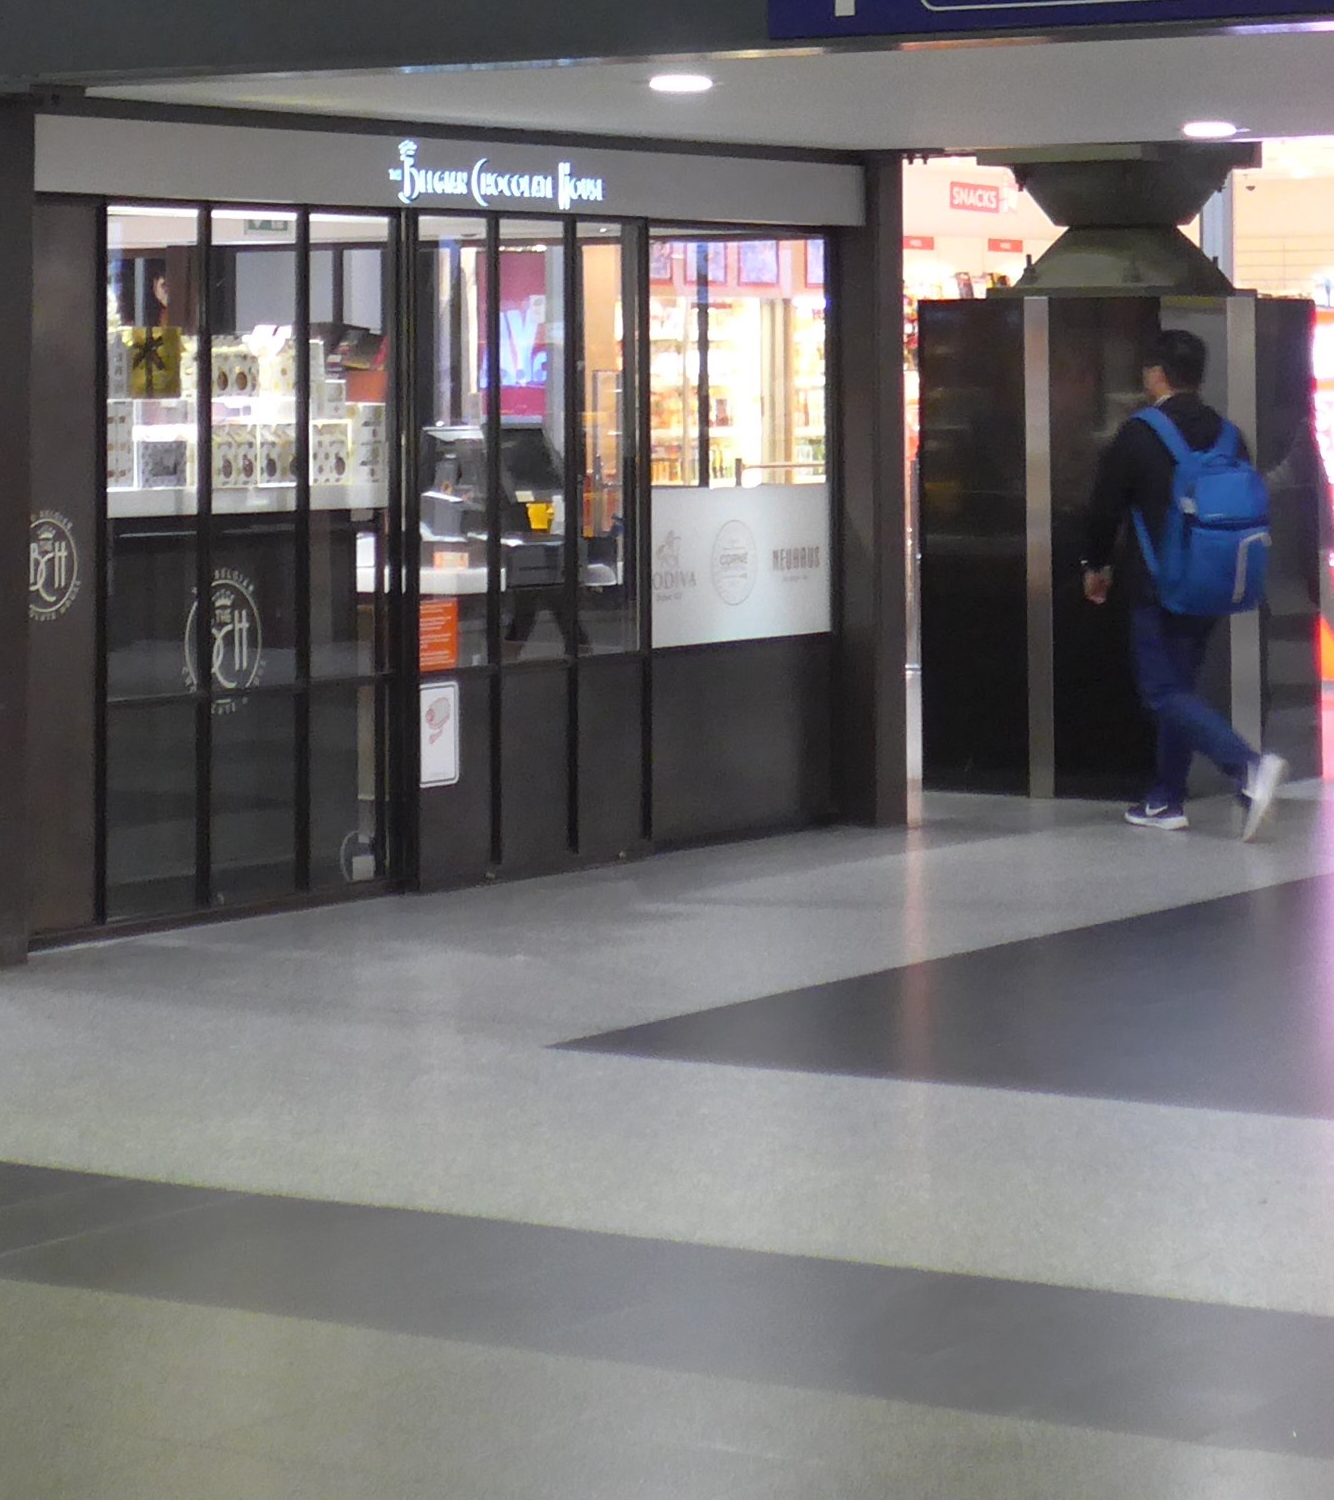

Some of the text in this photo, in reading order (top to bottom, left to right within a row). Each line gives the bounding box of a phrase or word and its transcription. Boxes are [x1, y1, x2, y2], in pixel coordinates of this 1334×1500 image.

[557, 161, 604, 210] HOUSE
[952, 186, 997, 210] SNACKS
[772, 546, 820, 571] NEUHAUS
[652, 571, 697, 591] ODIVA
